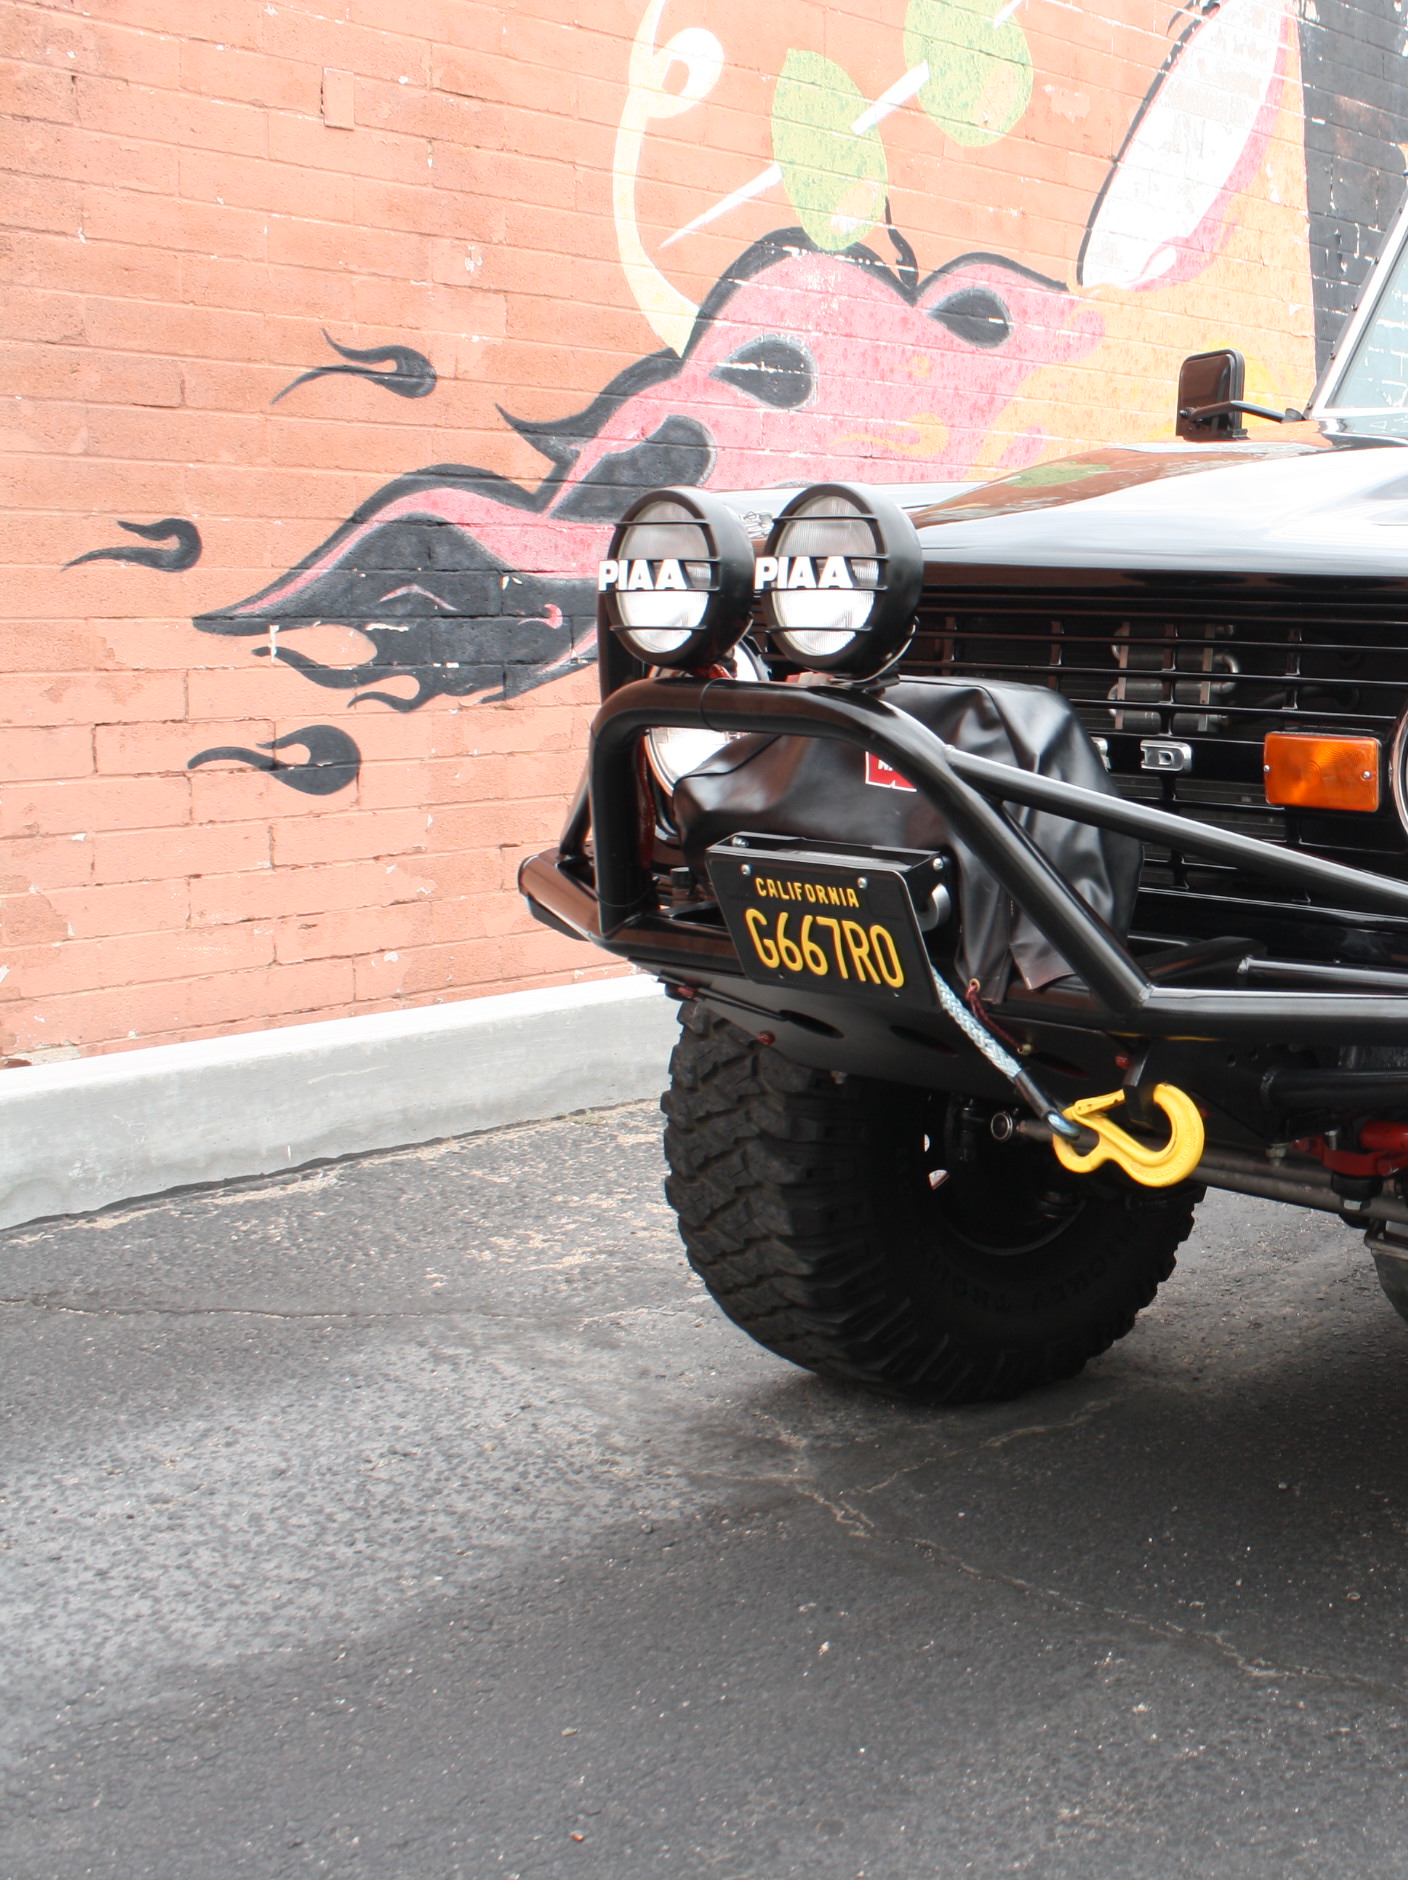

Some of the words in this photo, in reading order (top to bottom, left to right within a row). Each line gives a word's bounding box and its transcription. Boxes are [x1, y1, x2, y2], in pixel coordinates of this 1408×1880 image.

[598, 558, 688, 592] PIAA
[754, 555, 853, 590] PIAA
[754, 876, 860, 908] CALIFORNIA
